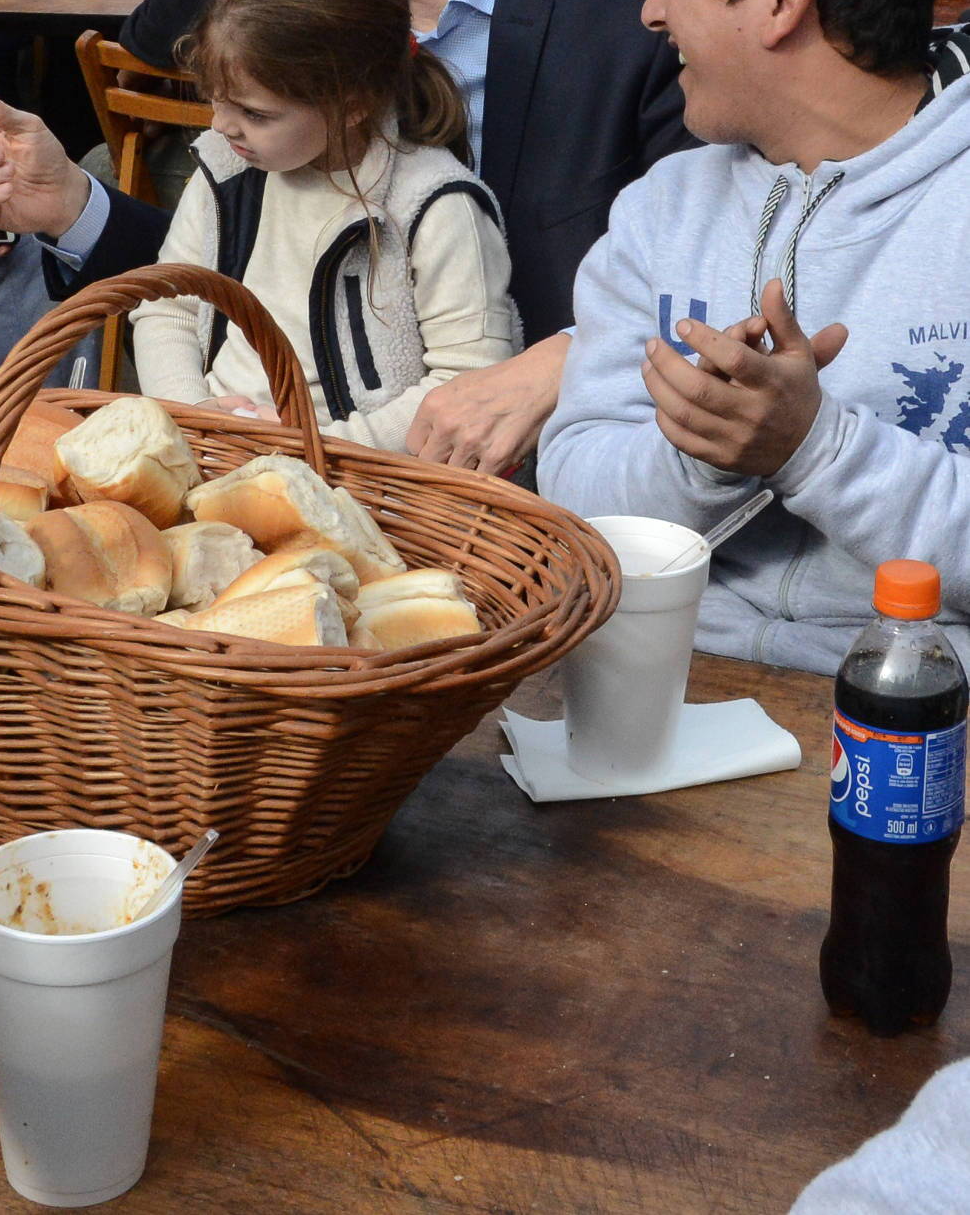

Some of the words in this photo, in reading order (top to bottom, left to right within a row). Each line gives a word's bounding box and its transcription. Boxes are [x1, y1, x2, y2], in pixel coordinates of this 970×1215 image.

[855, 754, 874, 818] pepsi
[887, 820, 905, 834] 500
[907, 820, 918, 834] ml
